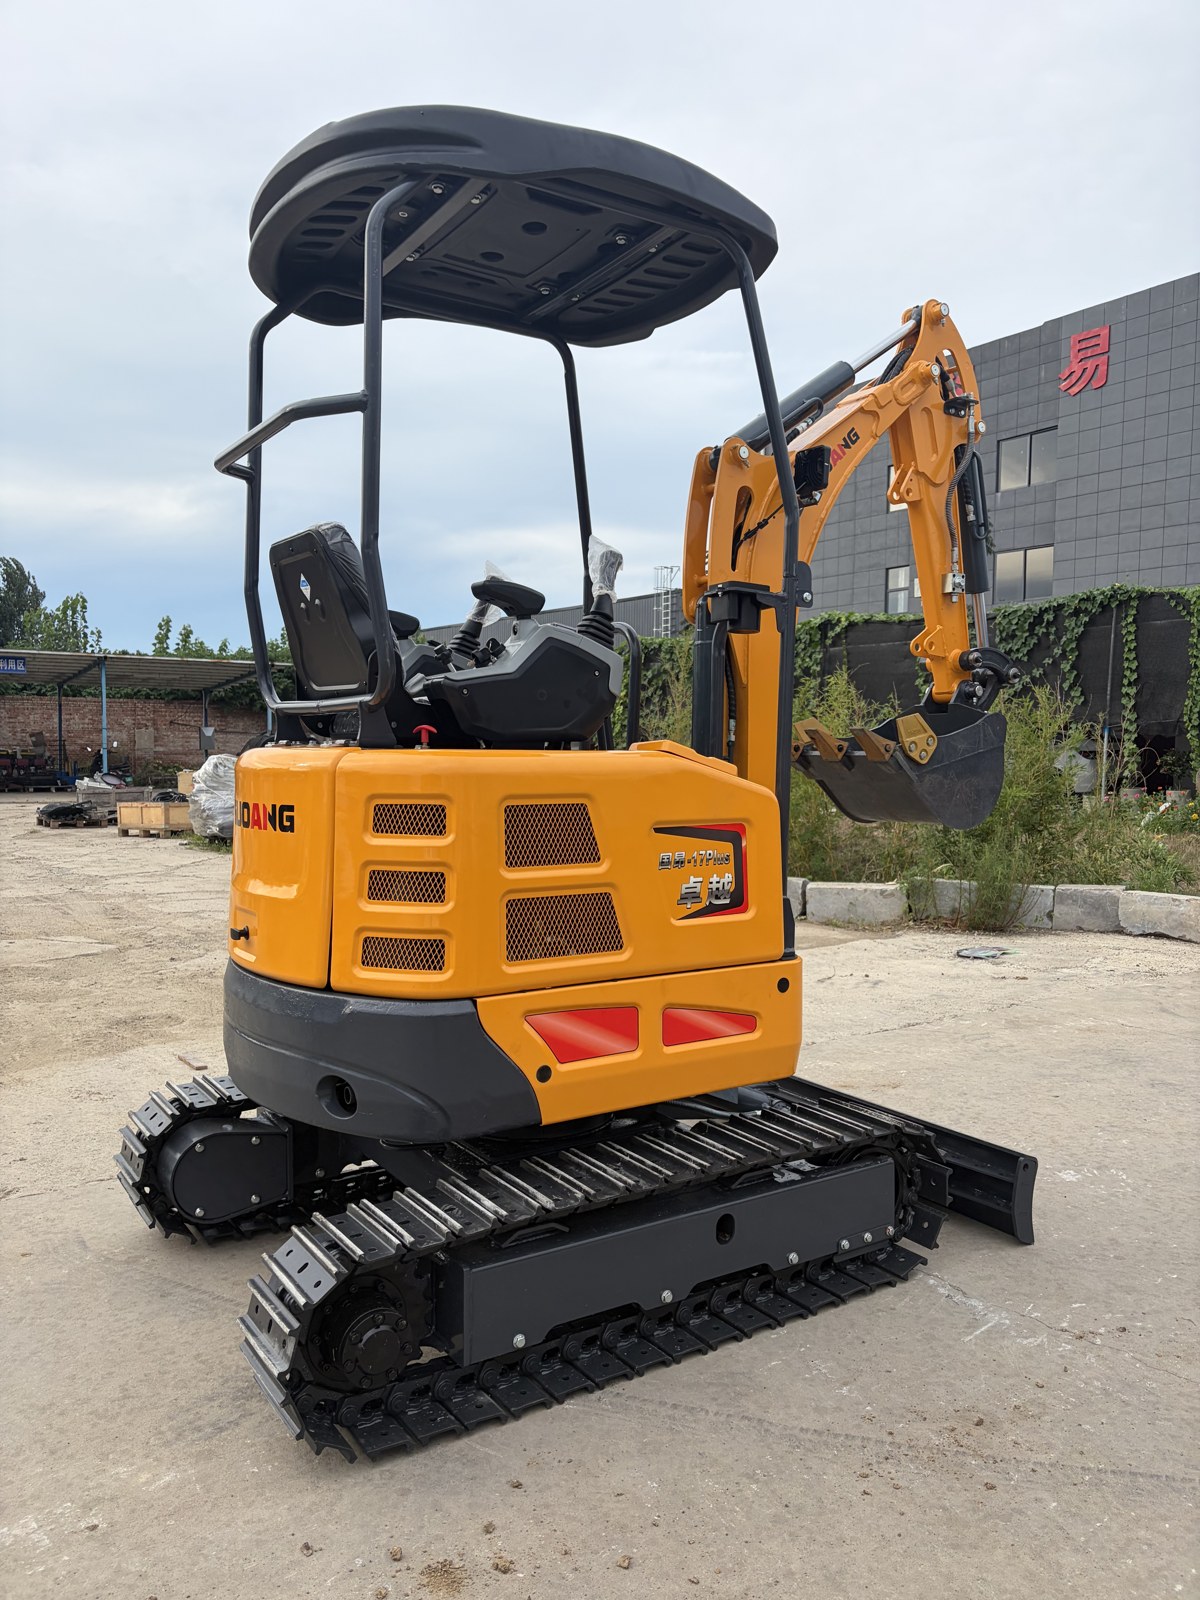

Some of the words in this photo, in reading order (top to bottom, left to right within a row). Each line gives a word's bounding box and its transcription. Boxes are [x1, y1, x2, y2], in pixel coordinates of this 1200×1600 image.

[1058, 324, 1110, 396] 易
[830, 426, 860, 472] ANG
[677, 873, 733, 909] 卓越
